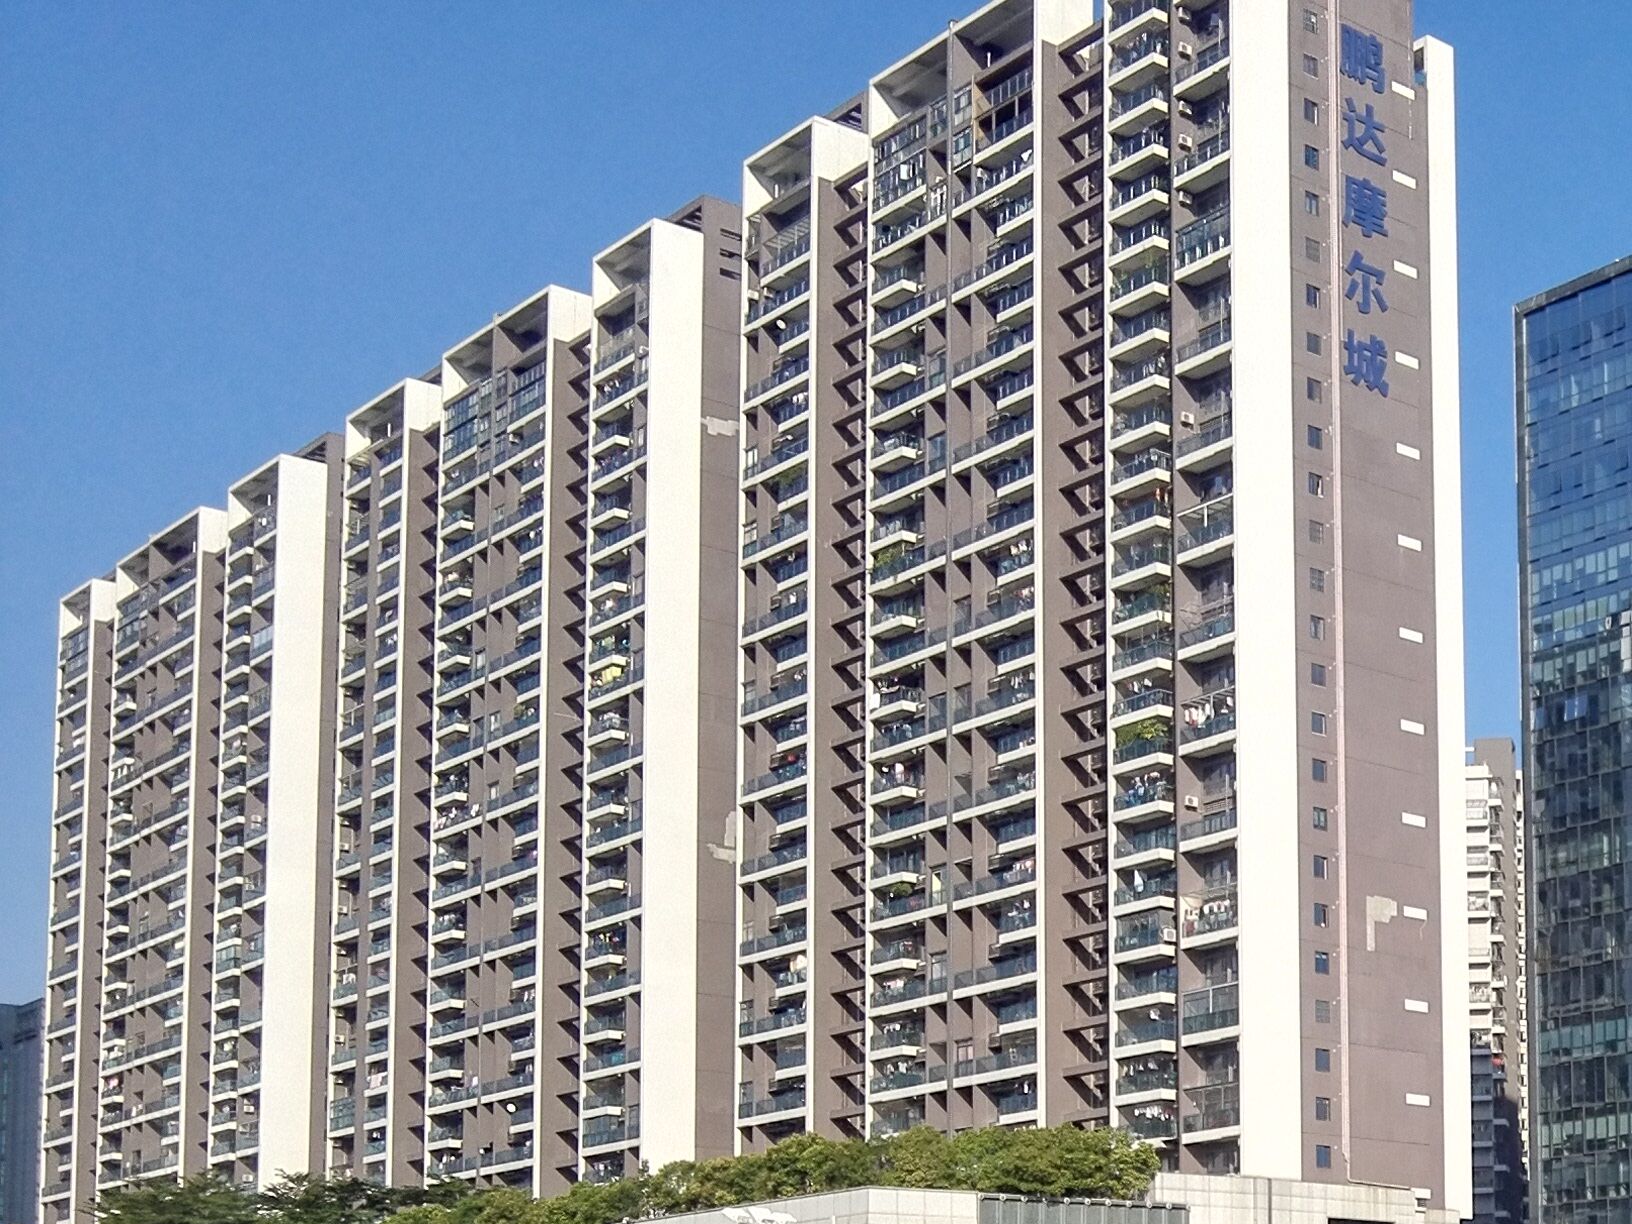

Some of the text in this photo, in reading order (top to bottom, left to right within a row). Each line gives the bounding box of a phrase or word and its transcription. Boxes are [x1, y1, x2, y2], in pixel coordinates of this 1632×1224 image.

[1340, 23, 1389, 398] 鹏达摩尔城
